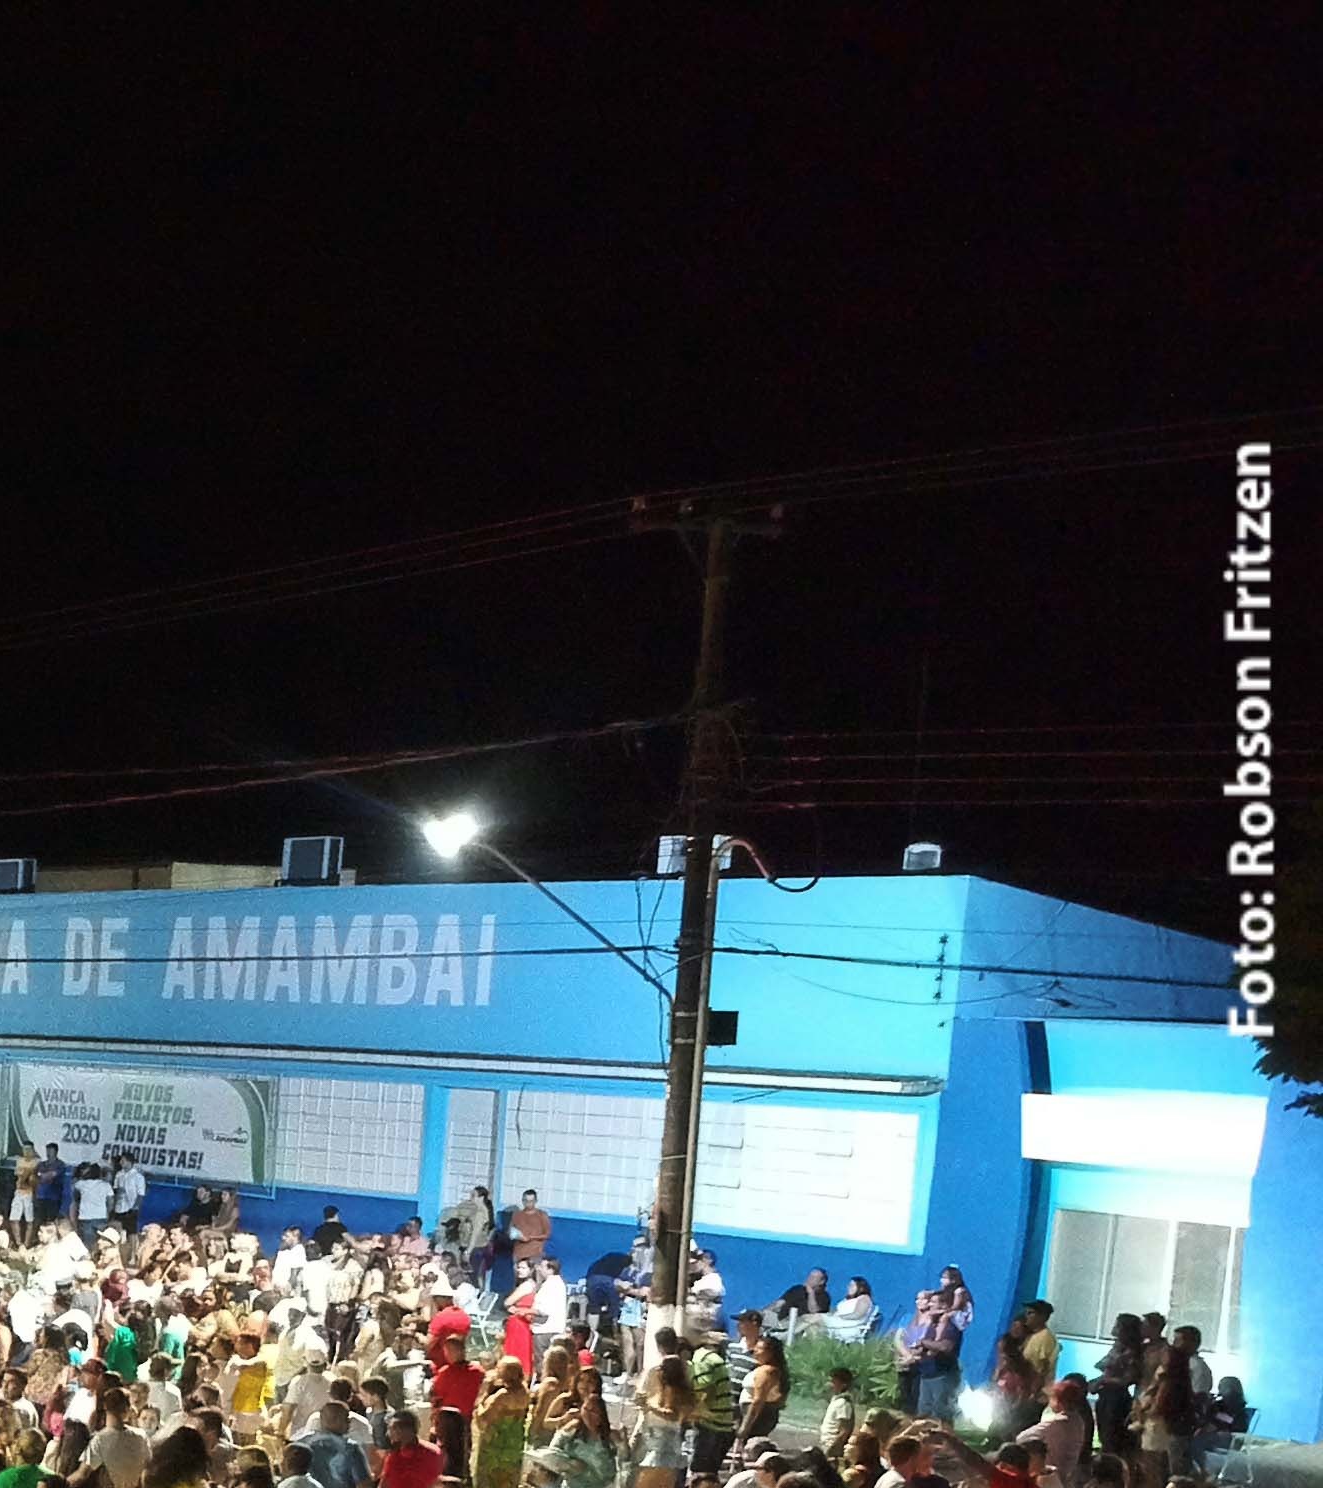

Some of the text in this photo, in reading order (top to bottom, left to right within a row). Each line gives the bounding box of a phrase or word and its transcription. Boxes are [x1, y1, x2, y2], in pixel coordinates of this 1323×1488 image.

[61, 916, 131, 997] DE
[161, 913, 497, 1007] AMAMBAI
[122, 1083, 175, 1104] NOVOS
[112, 1102, 196, 1127] PROJETOS,
[61, 1122, 101, 1146] 2020
[114, 1123, 168, 1146] NOVAS
